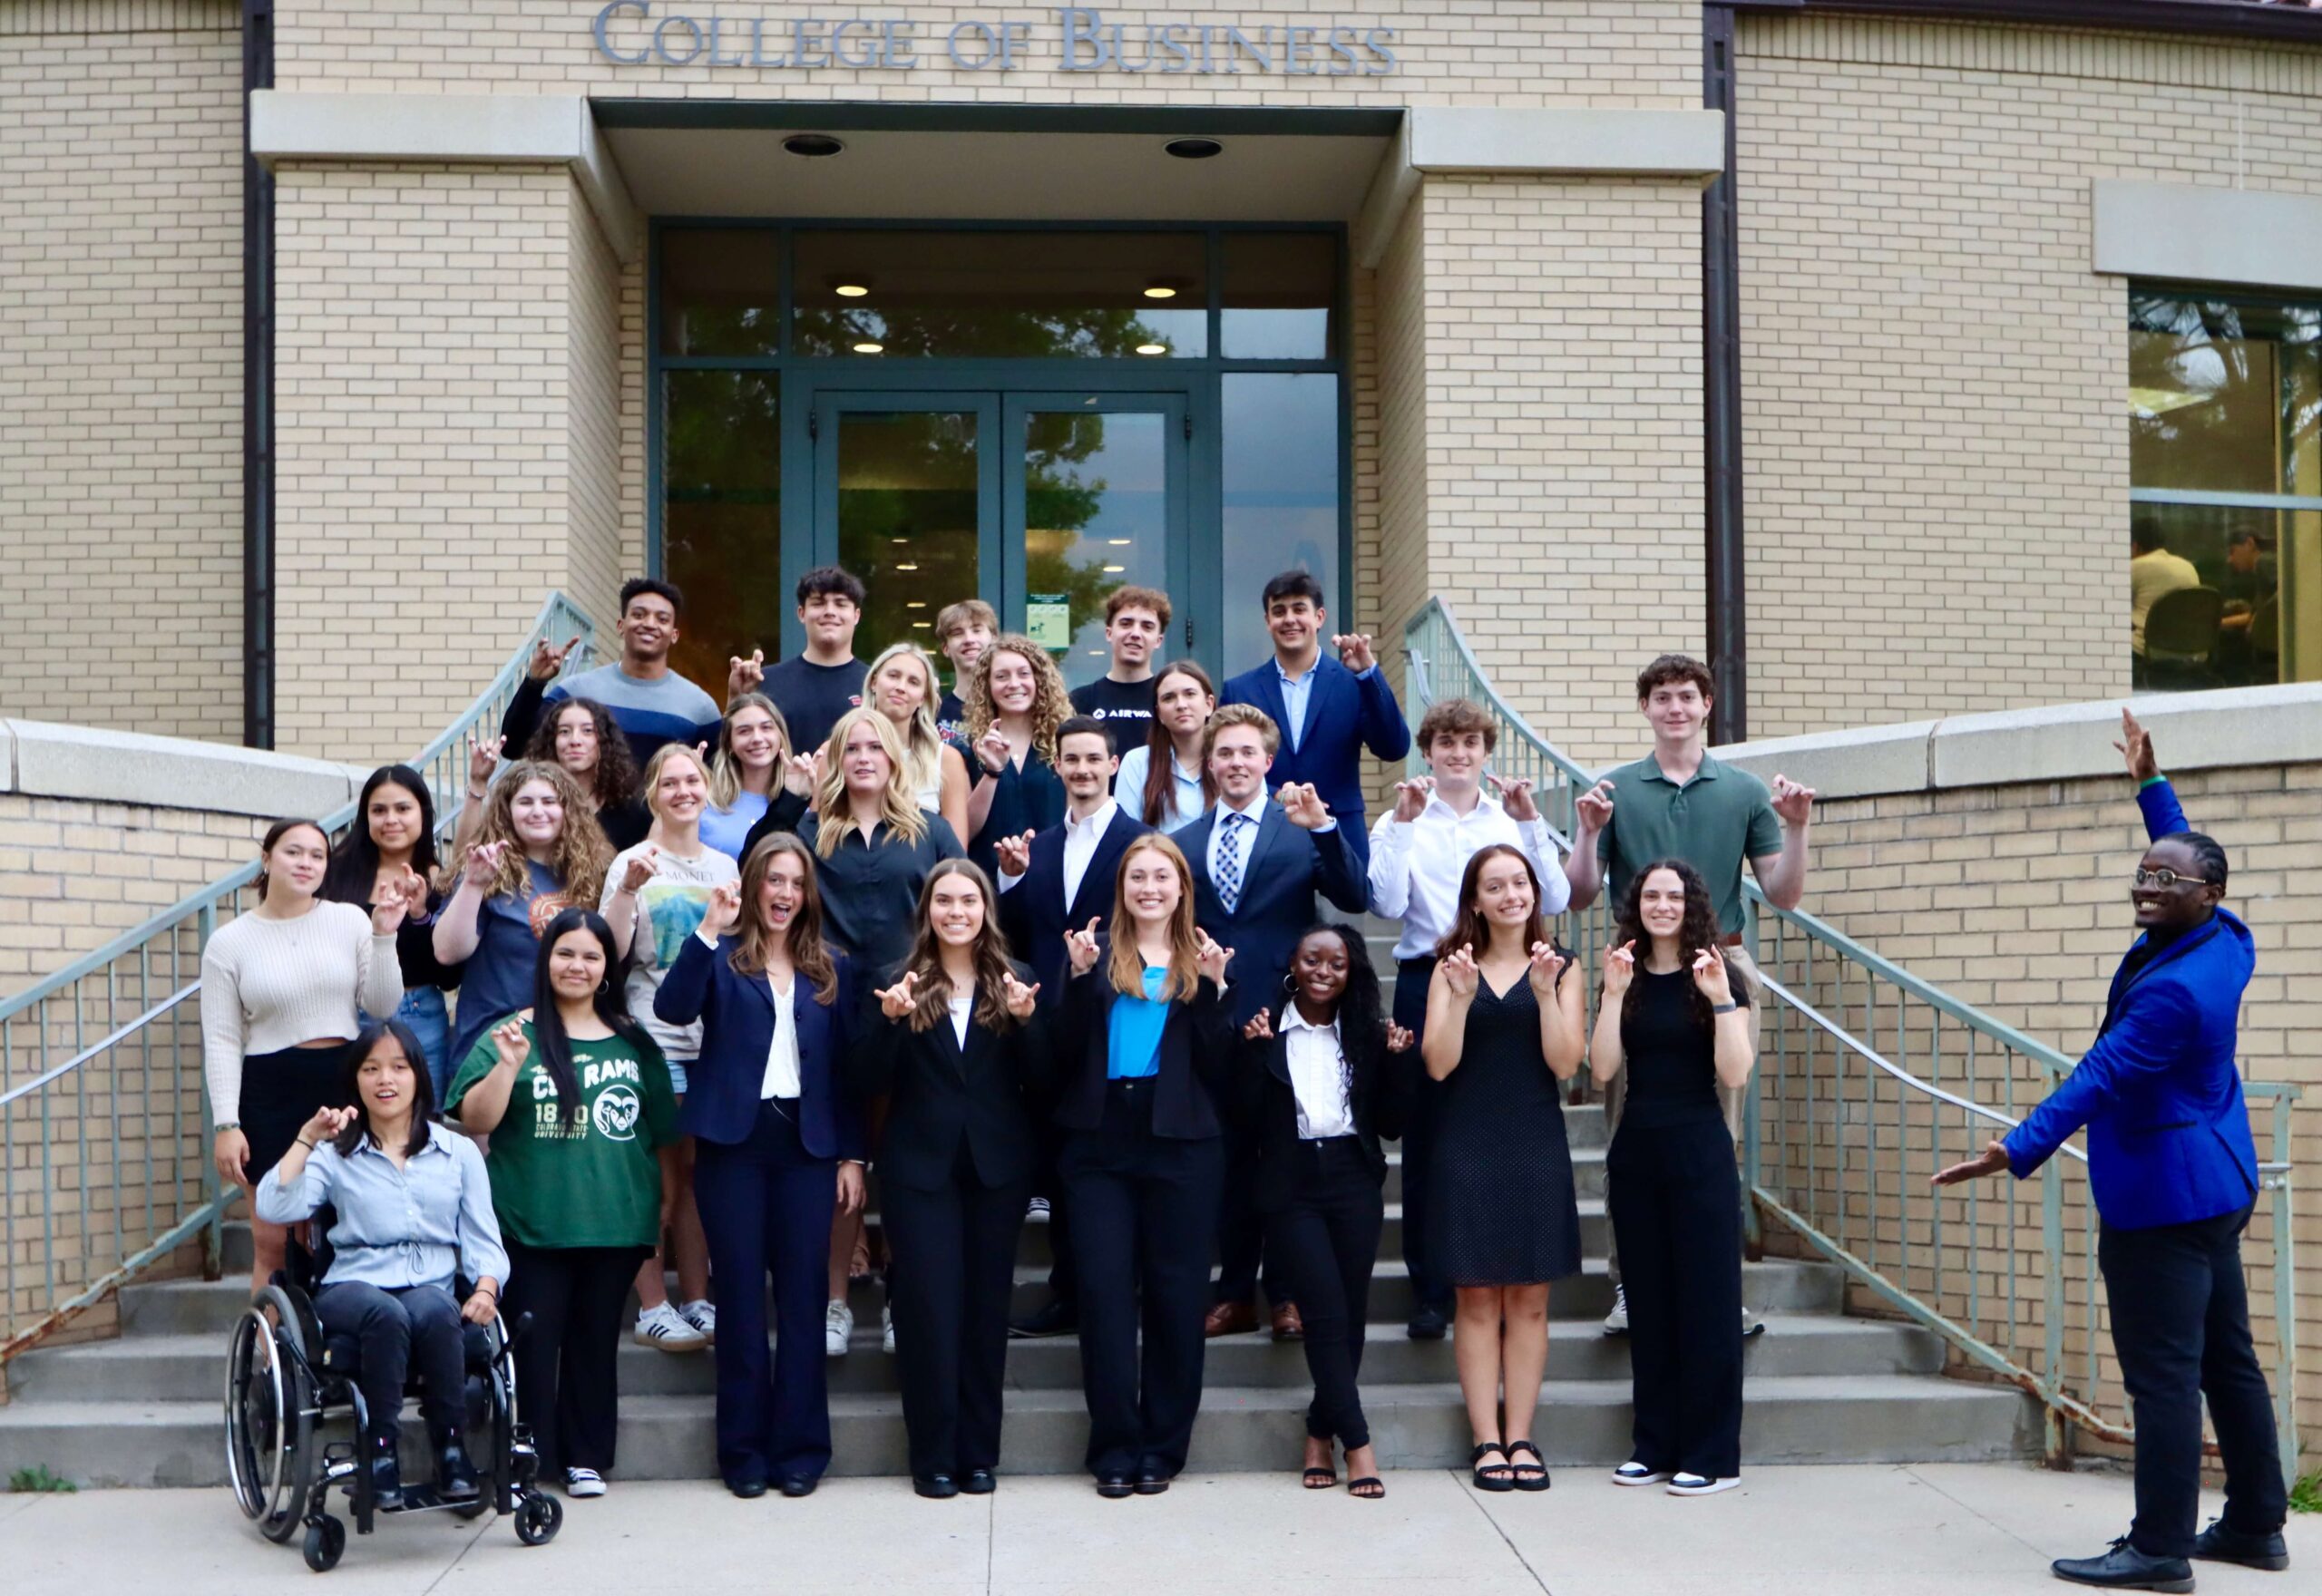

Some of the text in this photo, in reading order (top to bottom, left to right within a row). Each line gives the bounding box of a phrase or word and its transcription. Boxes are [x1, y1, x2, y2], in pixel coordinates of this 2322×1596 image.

[594, 0, 1395, 74] COLLEGE OF BUSINESS
[666, 871, 716, 882] MONET
[584, 1058, 639, 1089] RAMS
[535, 1103, 589, 1124] 180
